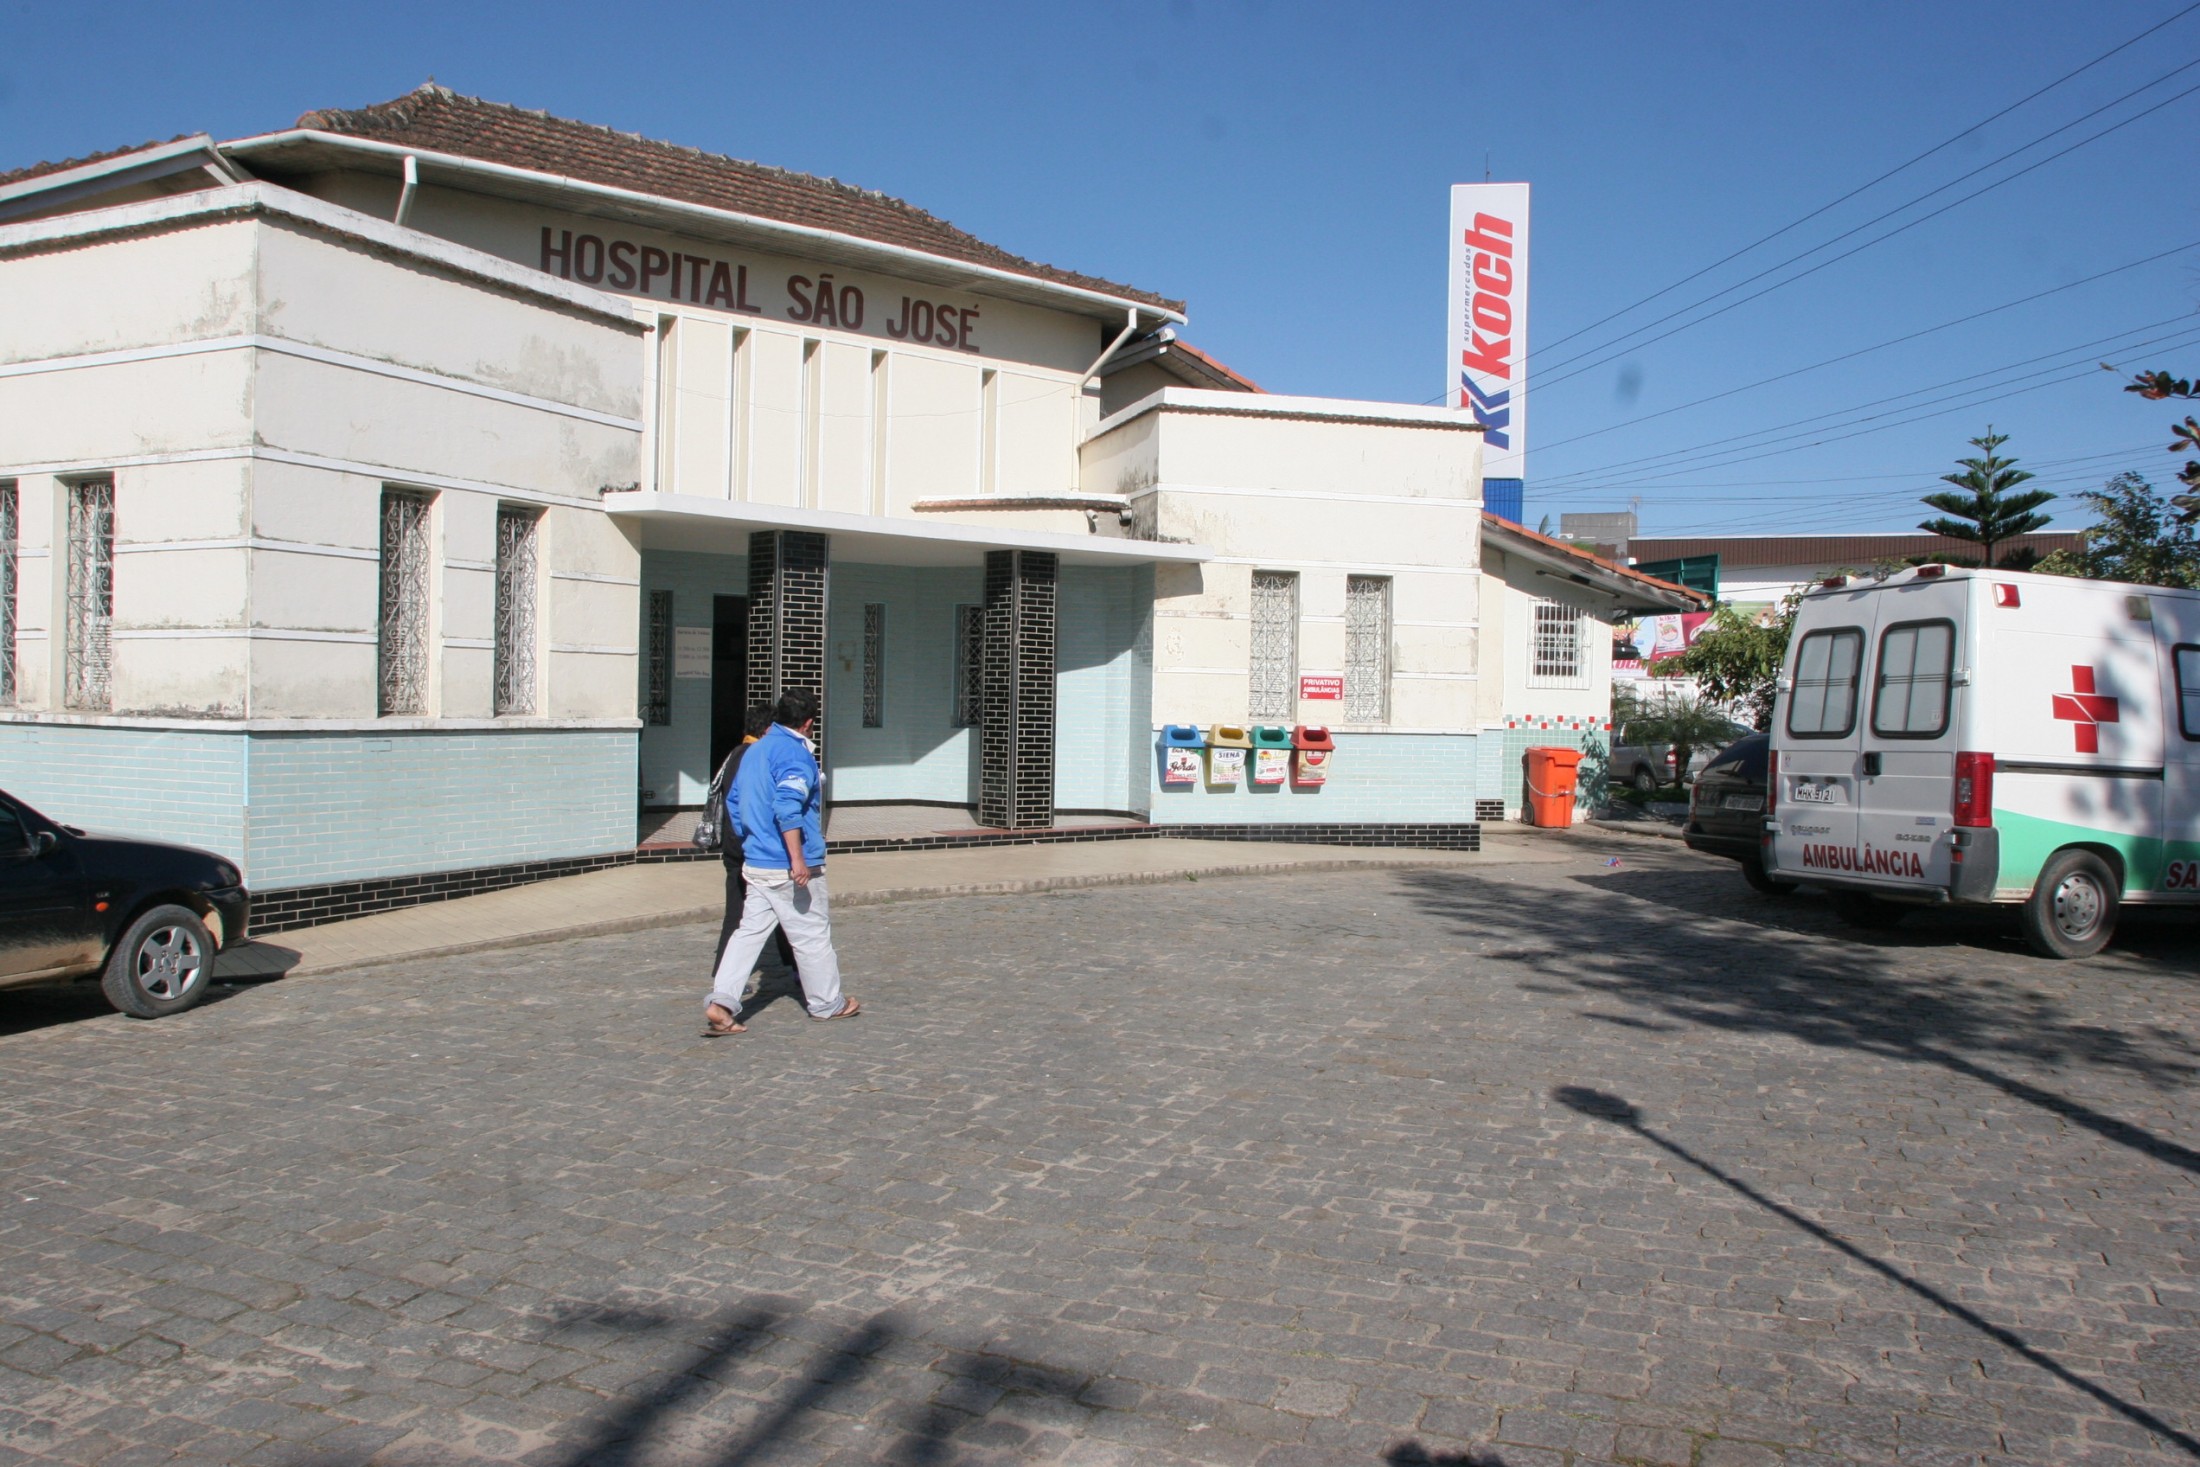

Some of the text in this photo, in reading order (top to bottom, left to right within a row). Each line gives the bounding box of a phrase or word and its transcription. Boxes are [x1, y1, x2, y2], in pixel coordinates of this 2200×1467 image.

[540, 226, 981, 353] HOSPITAL SÃO JOSÉ
[1462, 247, 1472, 342] supermercados
[1303, 678, 1341, 686] PRIVATIVO
[1802, 842, 1926, 879] AMBULÂNCIA
